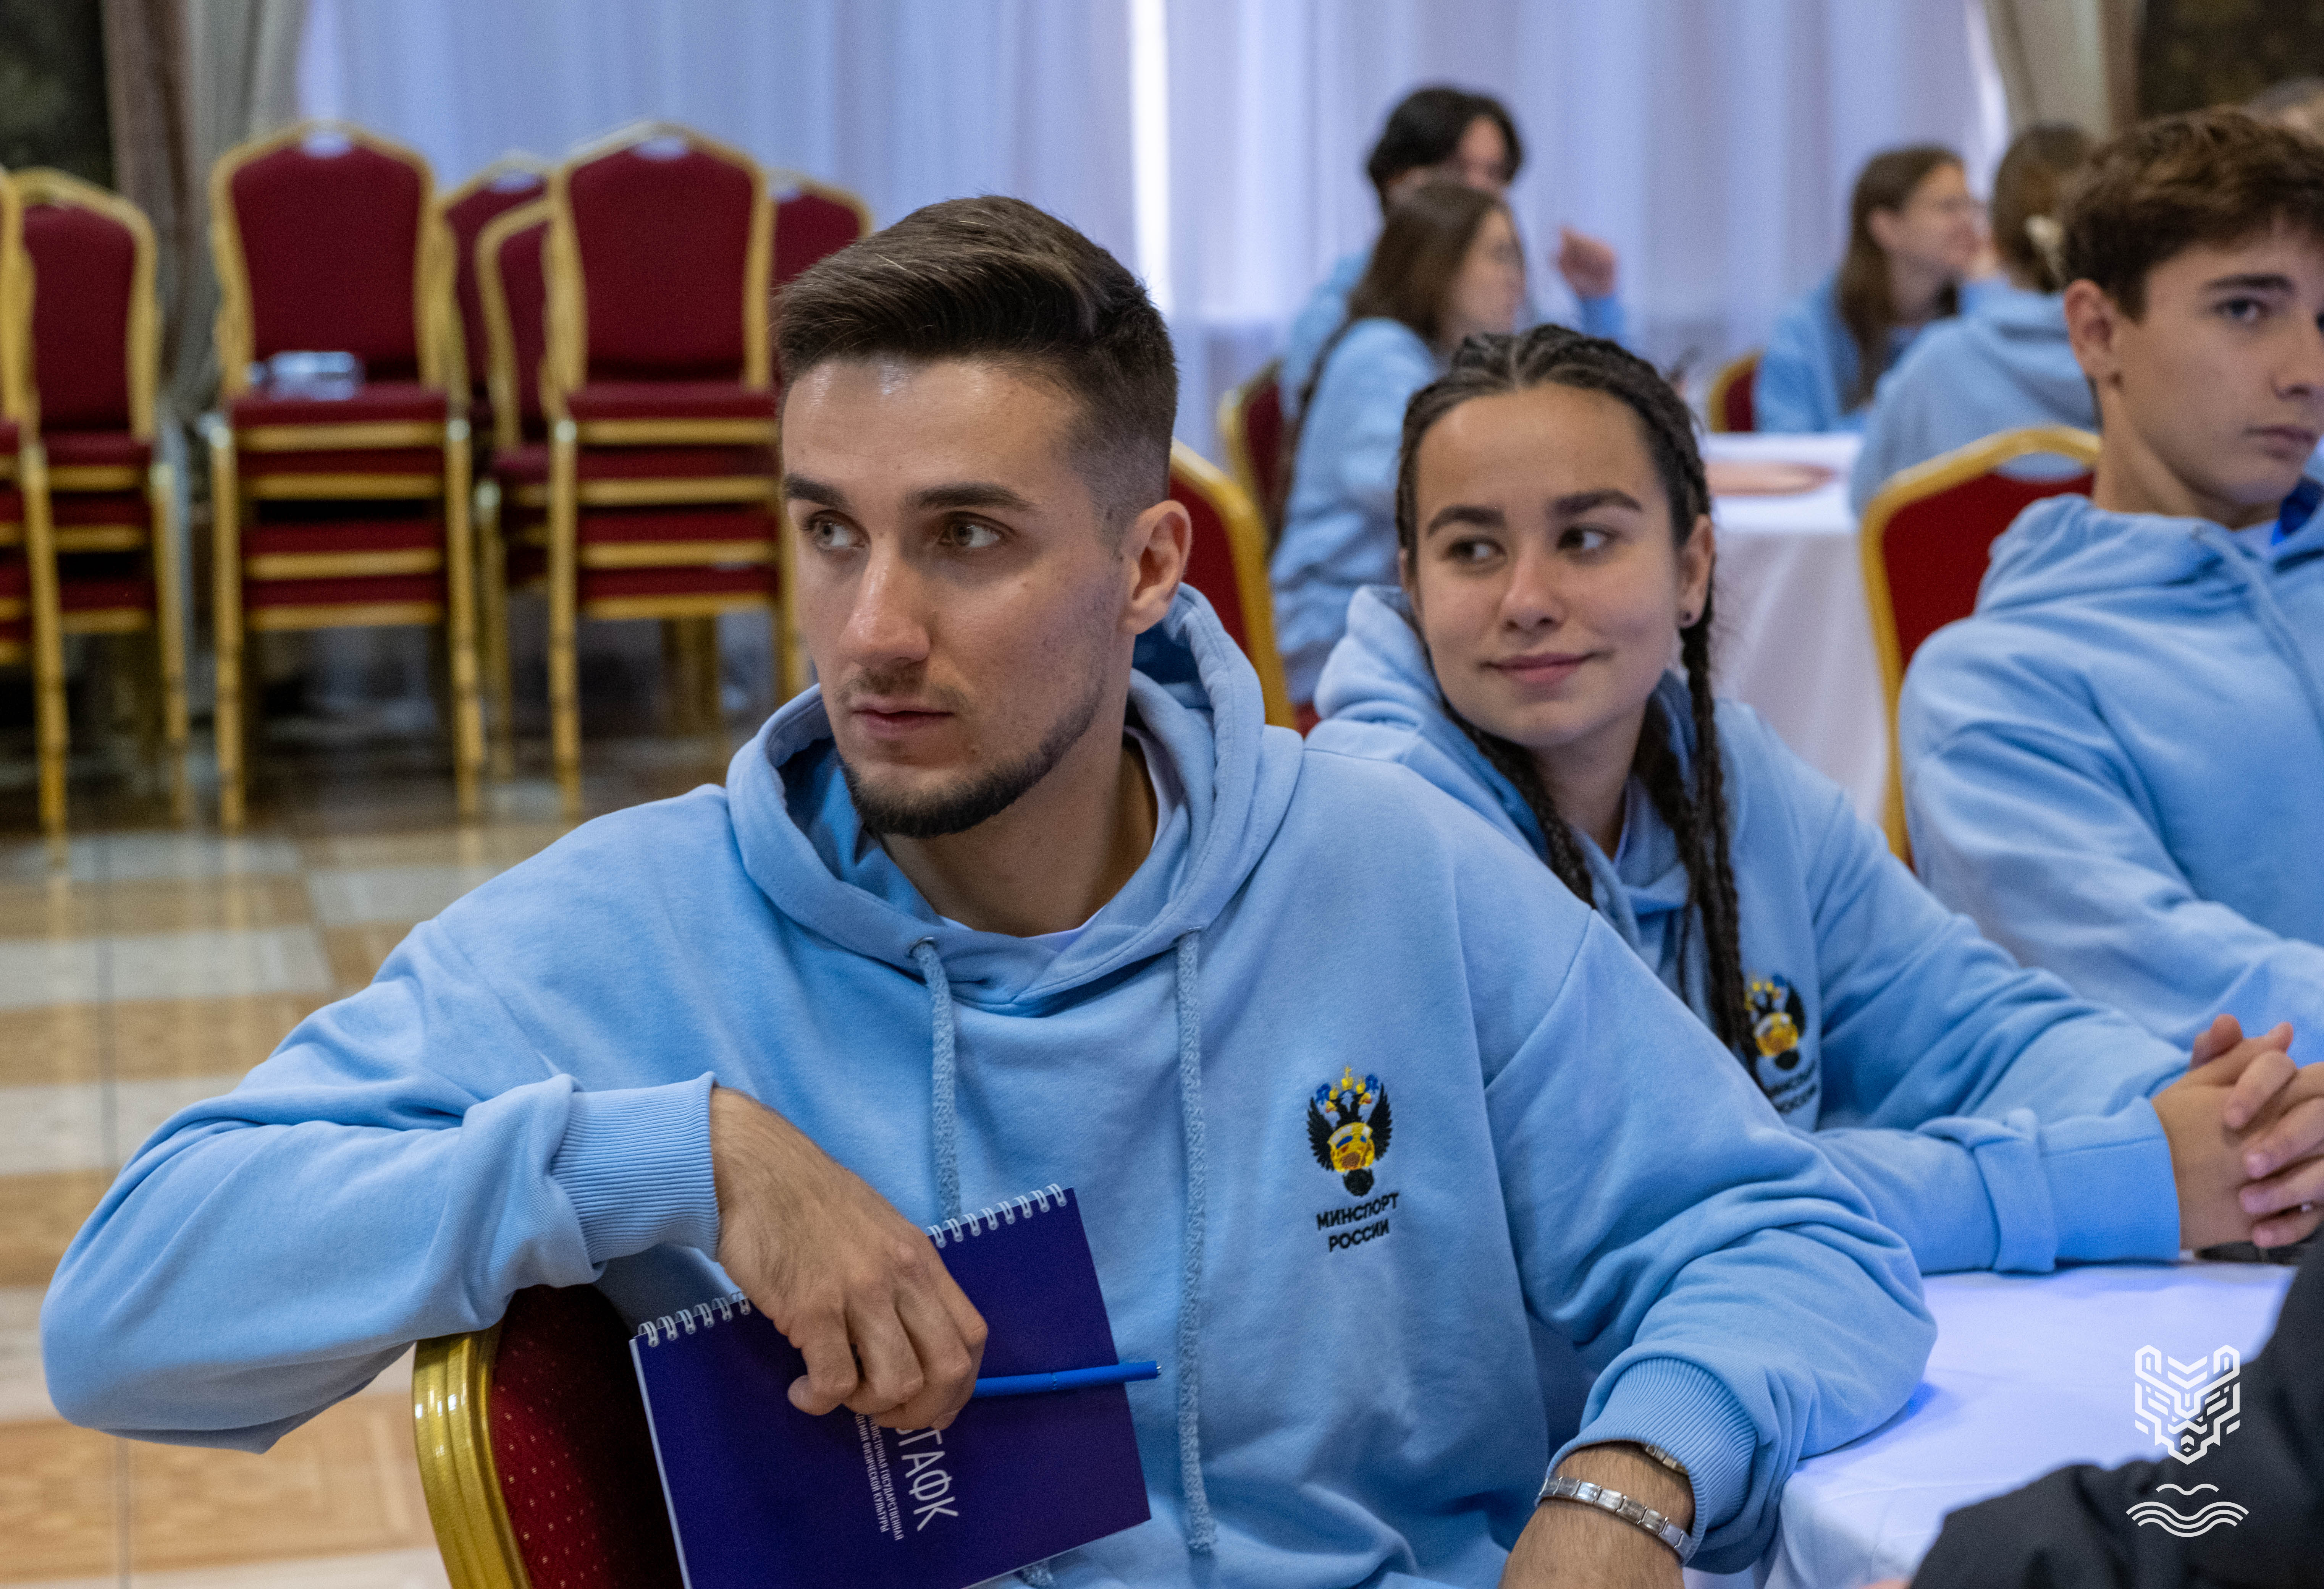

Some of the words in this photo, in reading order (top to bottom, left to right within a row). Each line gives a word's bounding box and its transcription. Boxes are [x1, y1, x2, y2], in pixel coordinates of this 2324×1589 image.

[1316, 1192, 1400, 1230] МИНСПОРТ
[1328, 1219, 1390, 1252] РОССИИ
[862, 1442, 882, 1492] ФИЗИЧЕСКОЙ
[873, 1492, 890, 1532] КУЛЬТУРЫ
[880, 1469, 904, 1540] ГОСУДАРСТВЕННАЯ
[895, 1428, 959, 1532] ГАФК
